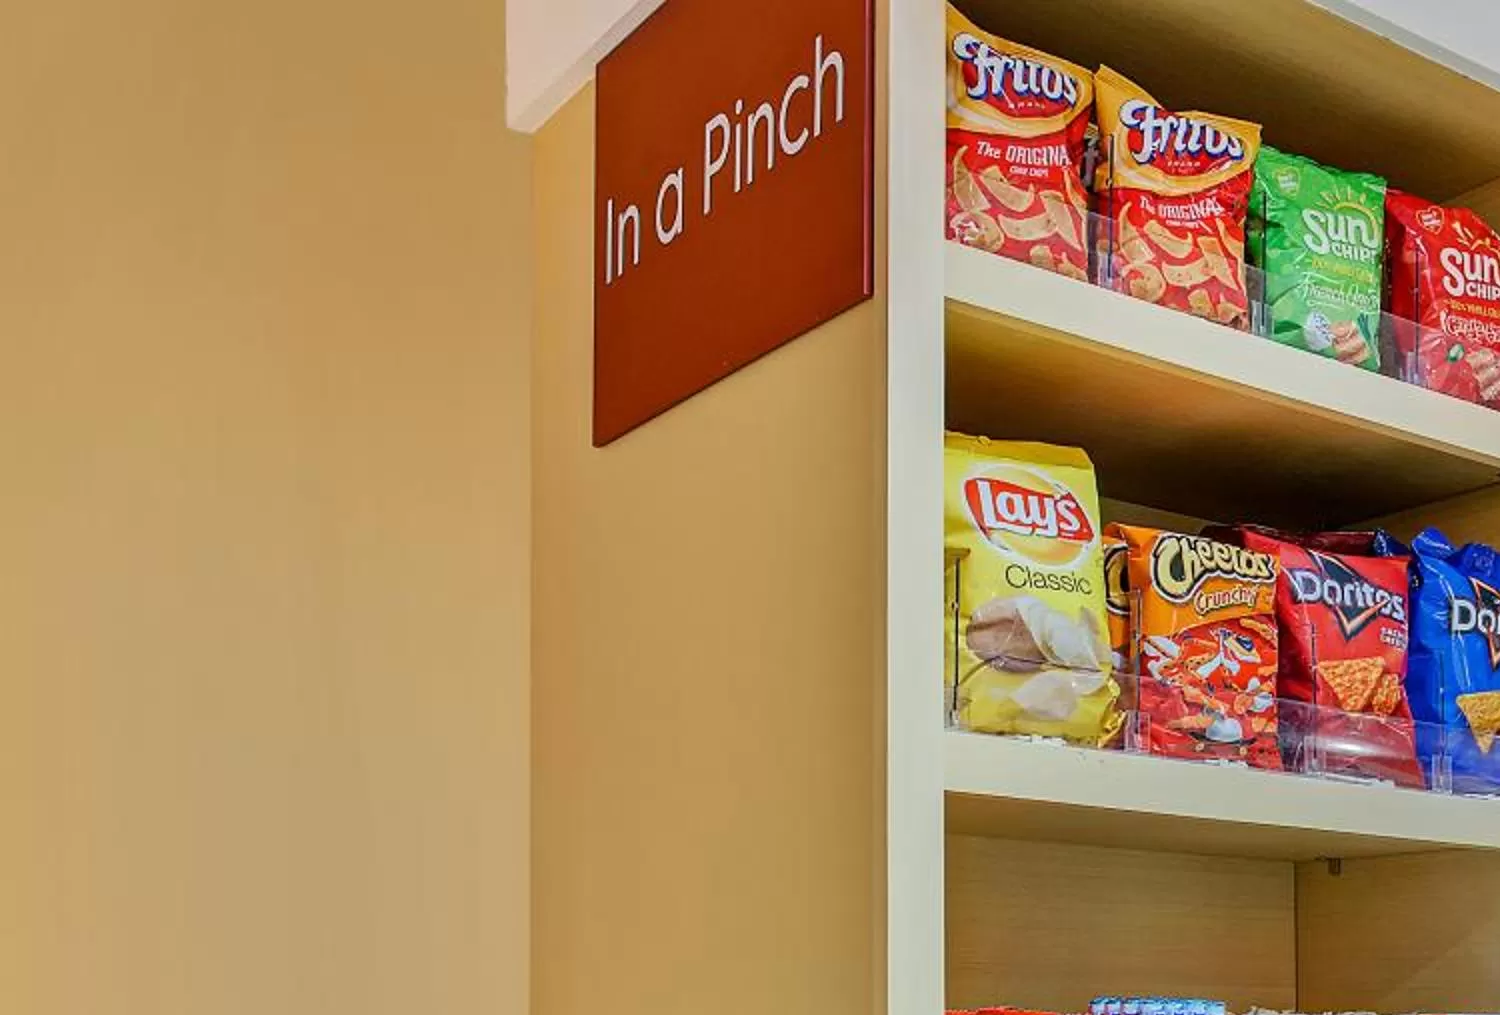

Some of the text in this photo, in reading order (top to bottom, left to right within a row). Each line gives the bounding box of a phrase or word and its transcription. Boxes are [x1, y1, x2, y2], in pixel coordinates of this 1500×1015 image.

[953, 32, 1077, 106] Fritos
[605, 33, 845, 285] In a Pinch
[1005, 144, 1072, 167] ORIGINA
[1119, 98, 1245, 164] Fritos
[1301, 208, 1379, 254] Sun
[977, 480, 1080, 538] Lay's
[1005, 564, 1093, 595] Classic
[1156, 535, 1273, 597] Cheetos
[1195, 582, 1259, 617] Crunchy
[1294, 569, 1406, 623] Doritos
